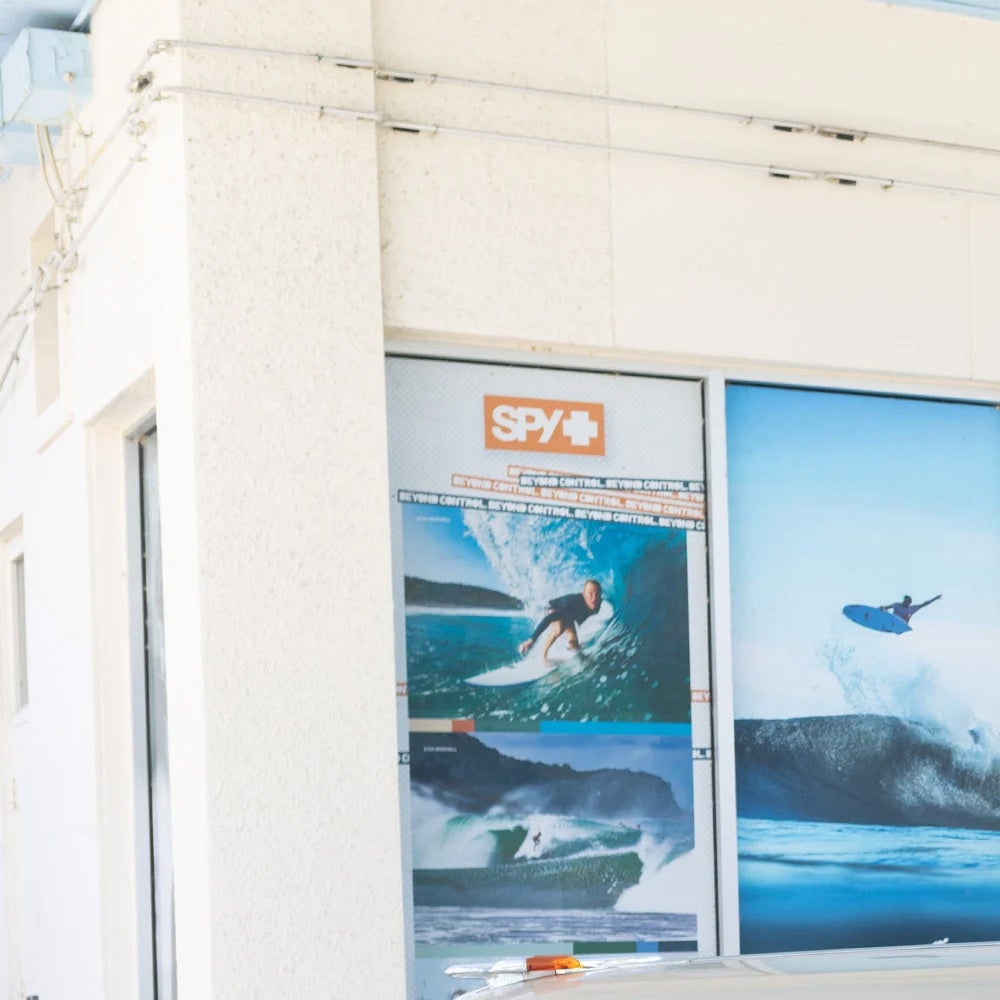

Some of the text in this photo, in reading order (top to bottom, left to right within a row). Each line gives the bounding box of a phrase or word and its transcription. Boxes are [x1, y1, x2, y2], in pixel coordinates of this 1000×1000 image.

[453, 476, 491, 490] BEYOND
[521, 476, 558, 487] BEYOND
[606, 479, 643, 490] BEYOND
[400, 492, 438, 505] BEYOND
[488, 501, 526, 514] BEYOND
[575, 509, 612, 522] BEYOND
[660, 517, 696, 530] BEYOND
